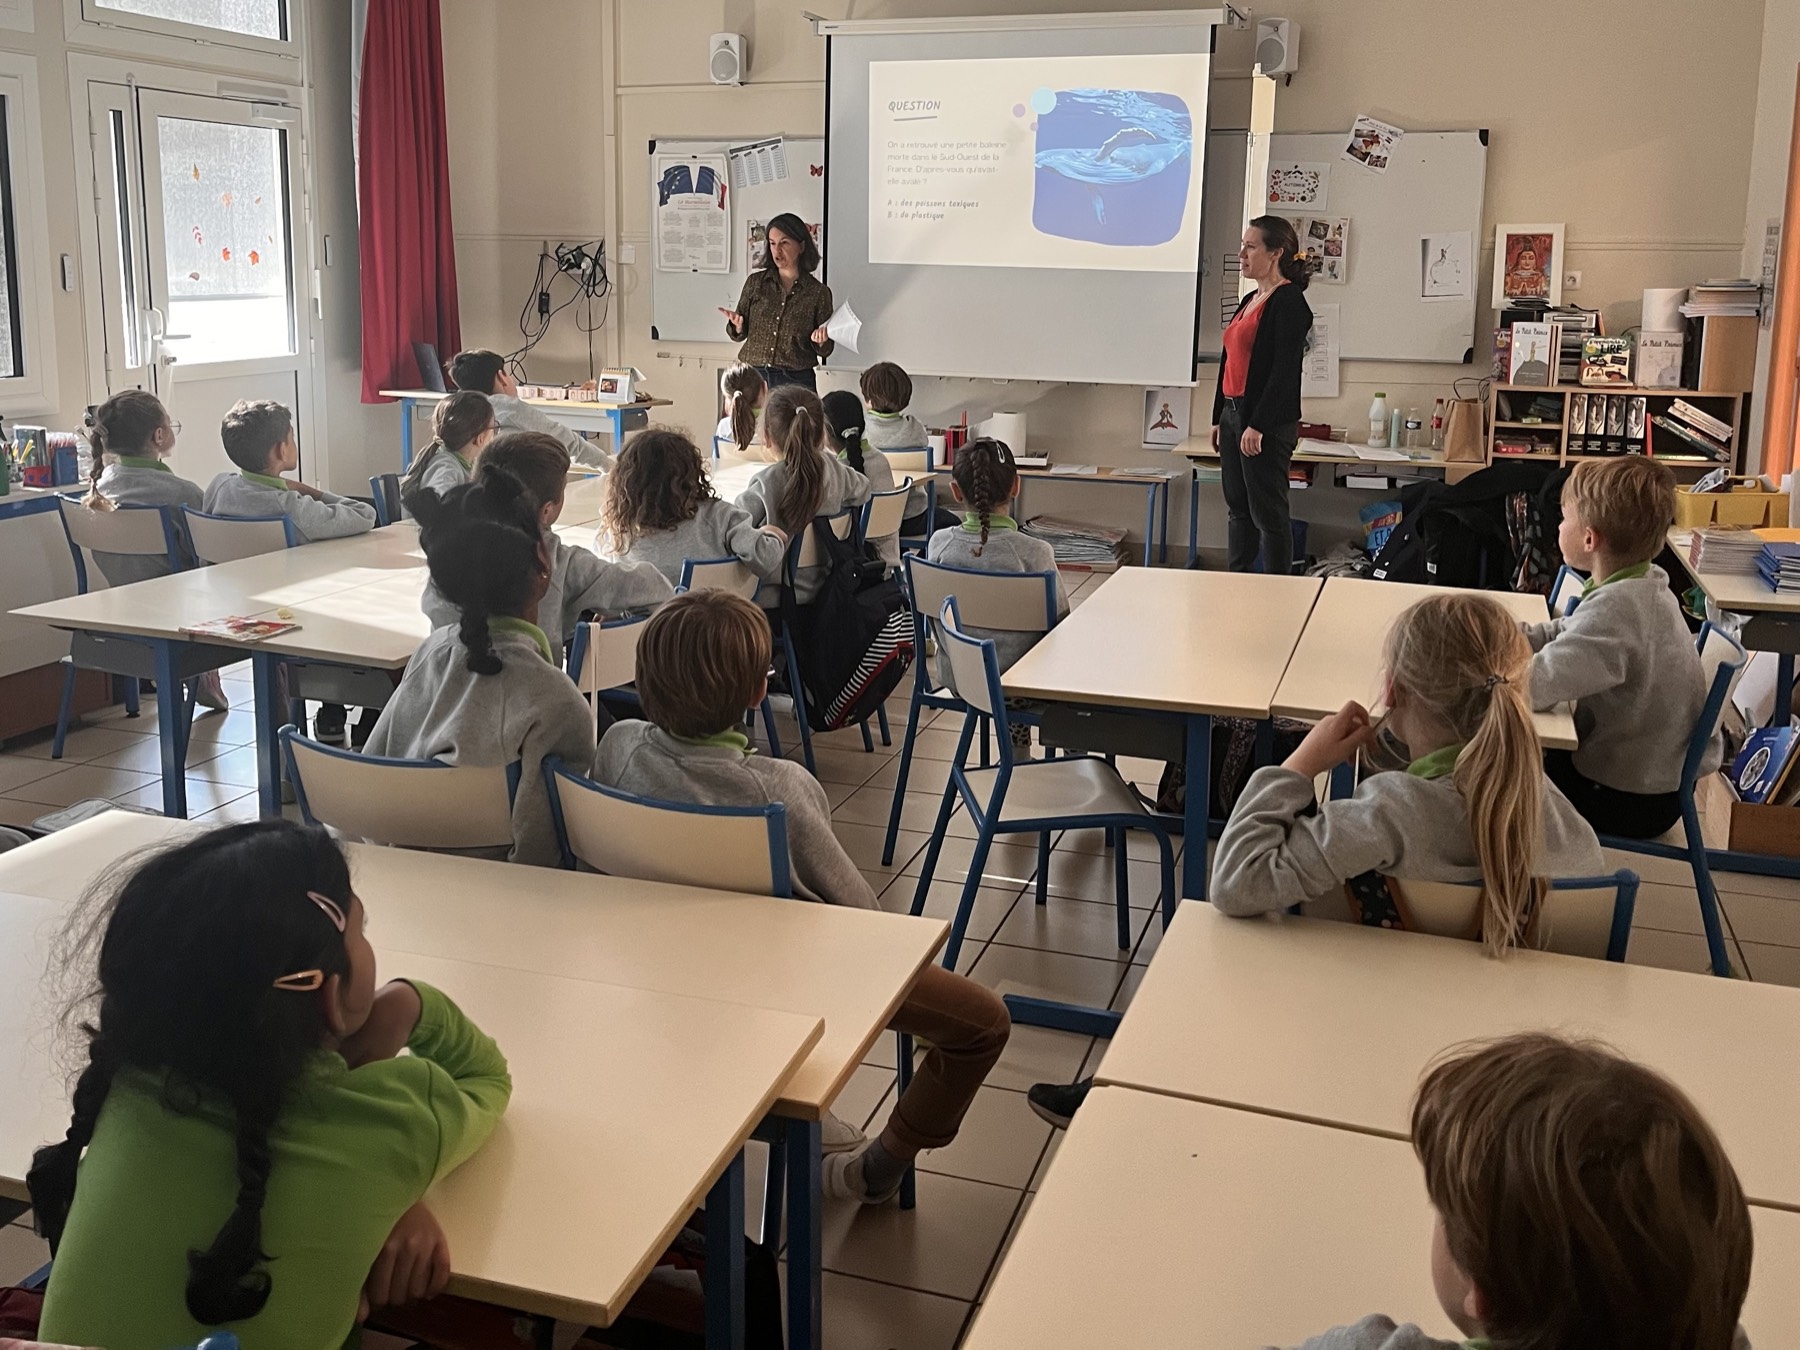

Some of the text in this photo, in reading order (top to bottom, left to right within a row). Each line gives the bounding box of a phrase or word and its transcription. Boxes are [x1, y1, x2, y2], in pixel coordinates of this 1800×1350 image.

[889, 100, 941, 112] QUESTION
[887, 141, 898, 149] On
[957, 141, 978, 151] petite
[979, 140, 1007, 149] baleine
[912, 153, 929, 161] dans
[931, 153, 938, 161] le
[981, 153, 991, 161] de
[992, 153, 1000, 161] la
[900, 199, 913, 207] des
[914, 200, 946, 209] poissons
[948, 200, 980, 209] toxiques
[911, 211, 945, 221] plastique
[1600, 344, 1623, 355] LIRE
